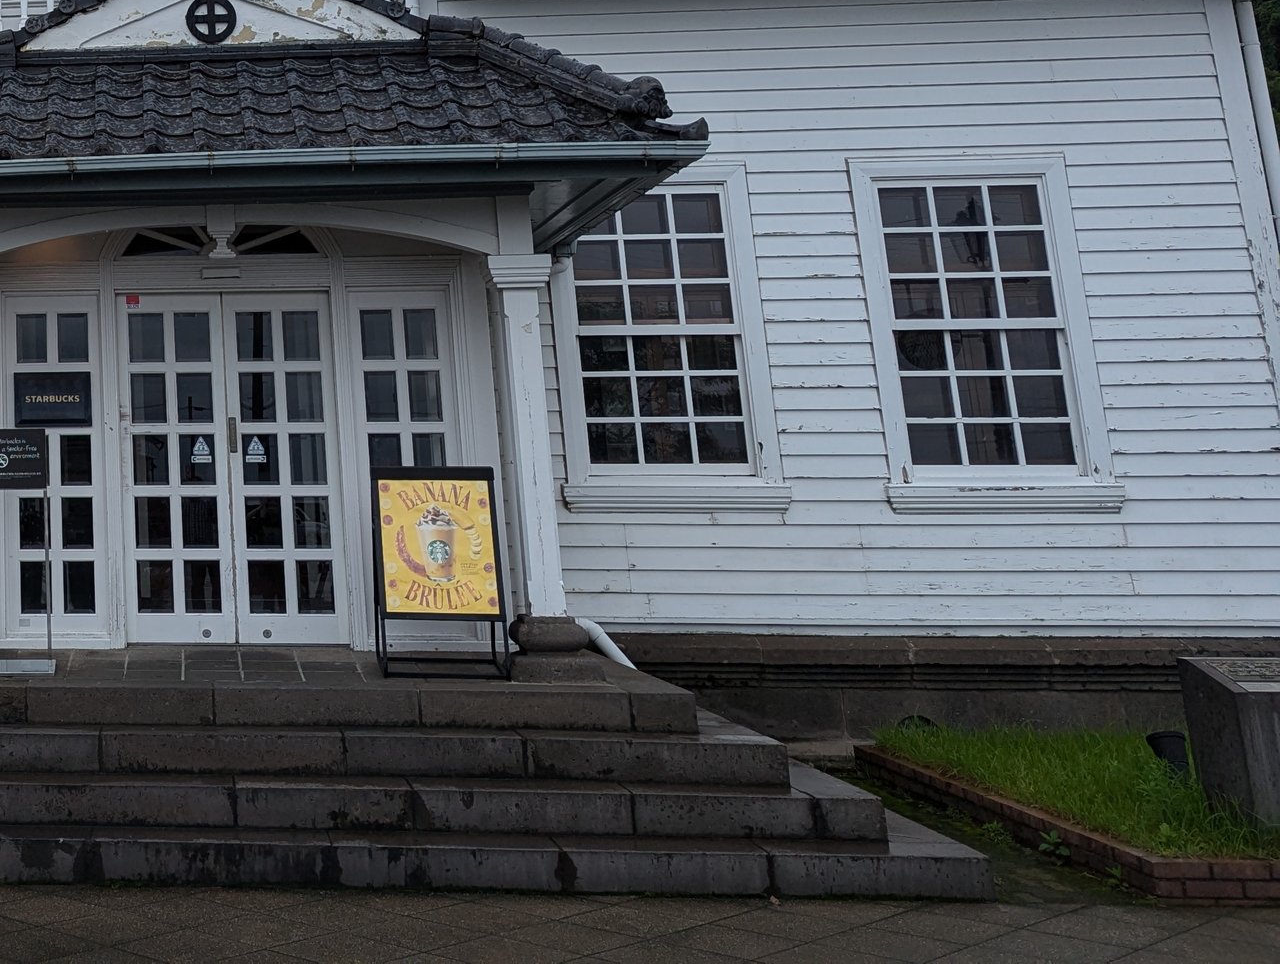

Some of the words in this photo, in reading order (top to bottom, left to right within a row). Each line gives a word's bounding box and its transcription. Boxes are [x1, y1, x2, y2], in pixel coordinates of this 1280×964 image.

[25, 395, 80, 403] STARBUCKS
[396, 481, 471, 511] BANANA
[404, 580, 483, 610] BRÛLÉE
